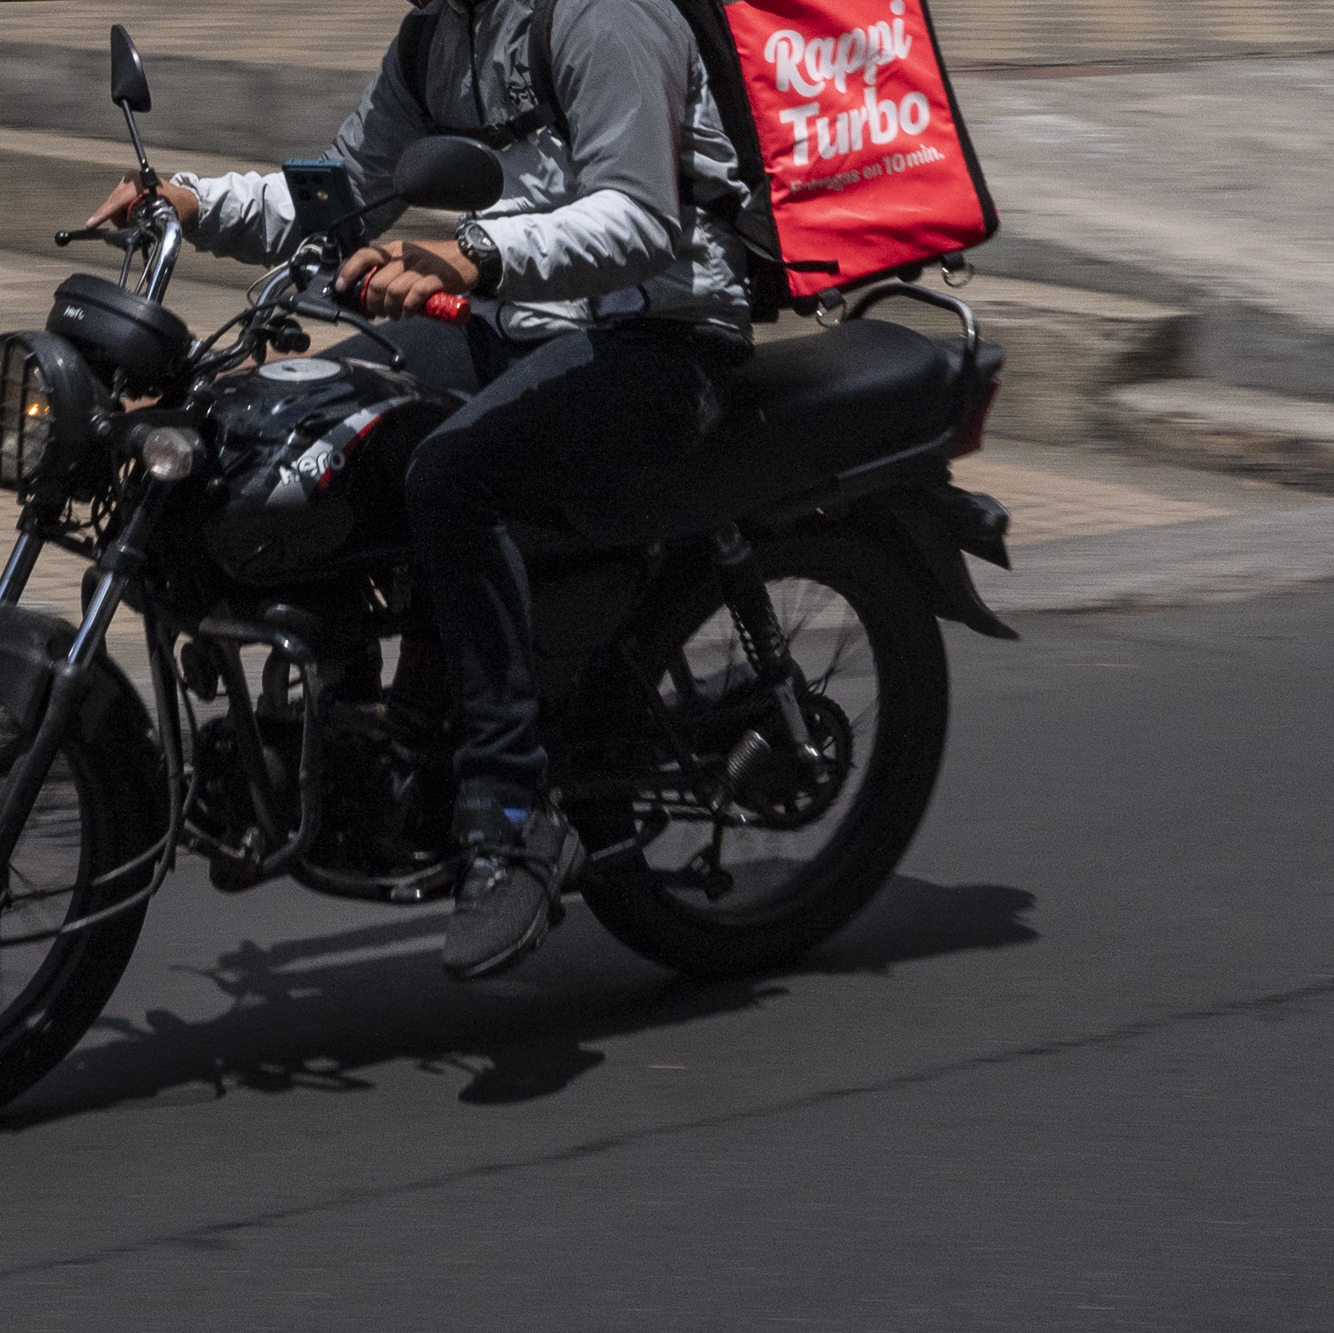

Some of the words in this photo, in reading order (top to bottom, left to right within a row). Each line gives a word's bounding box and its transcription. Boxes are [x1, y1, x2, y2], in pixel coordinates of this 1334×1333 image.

[779, 87, 931, 167] Turbo
[882, 152, 906, 175] 10
[278, 450, 346, 486] Hero
